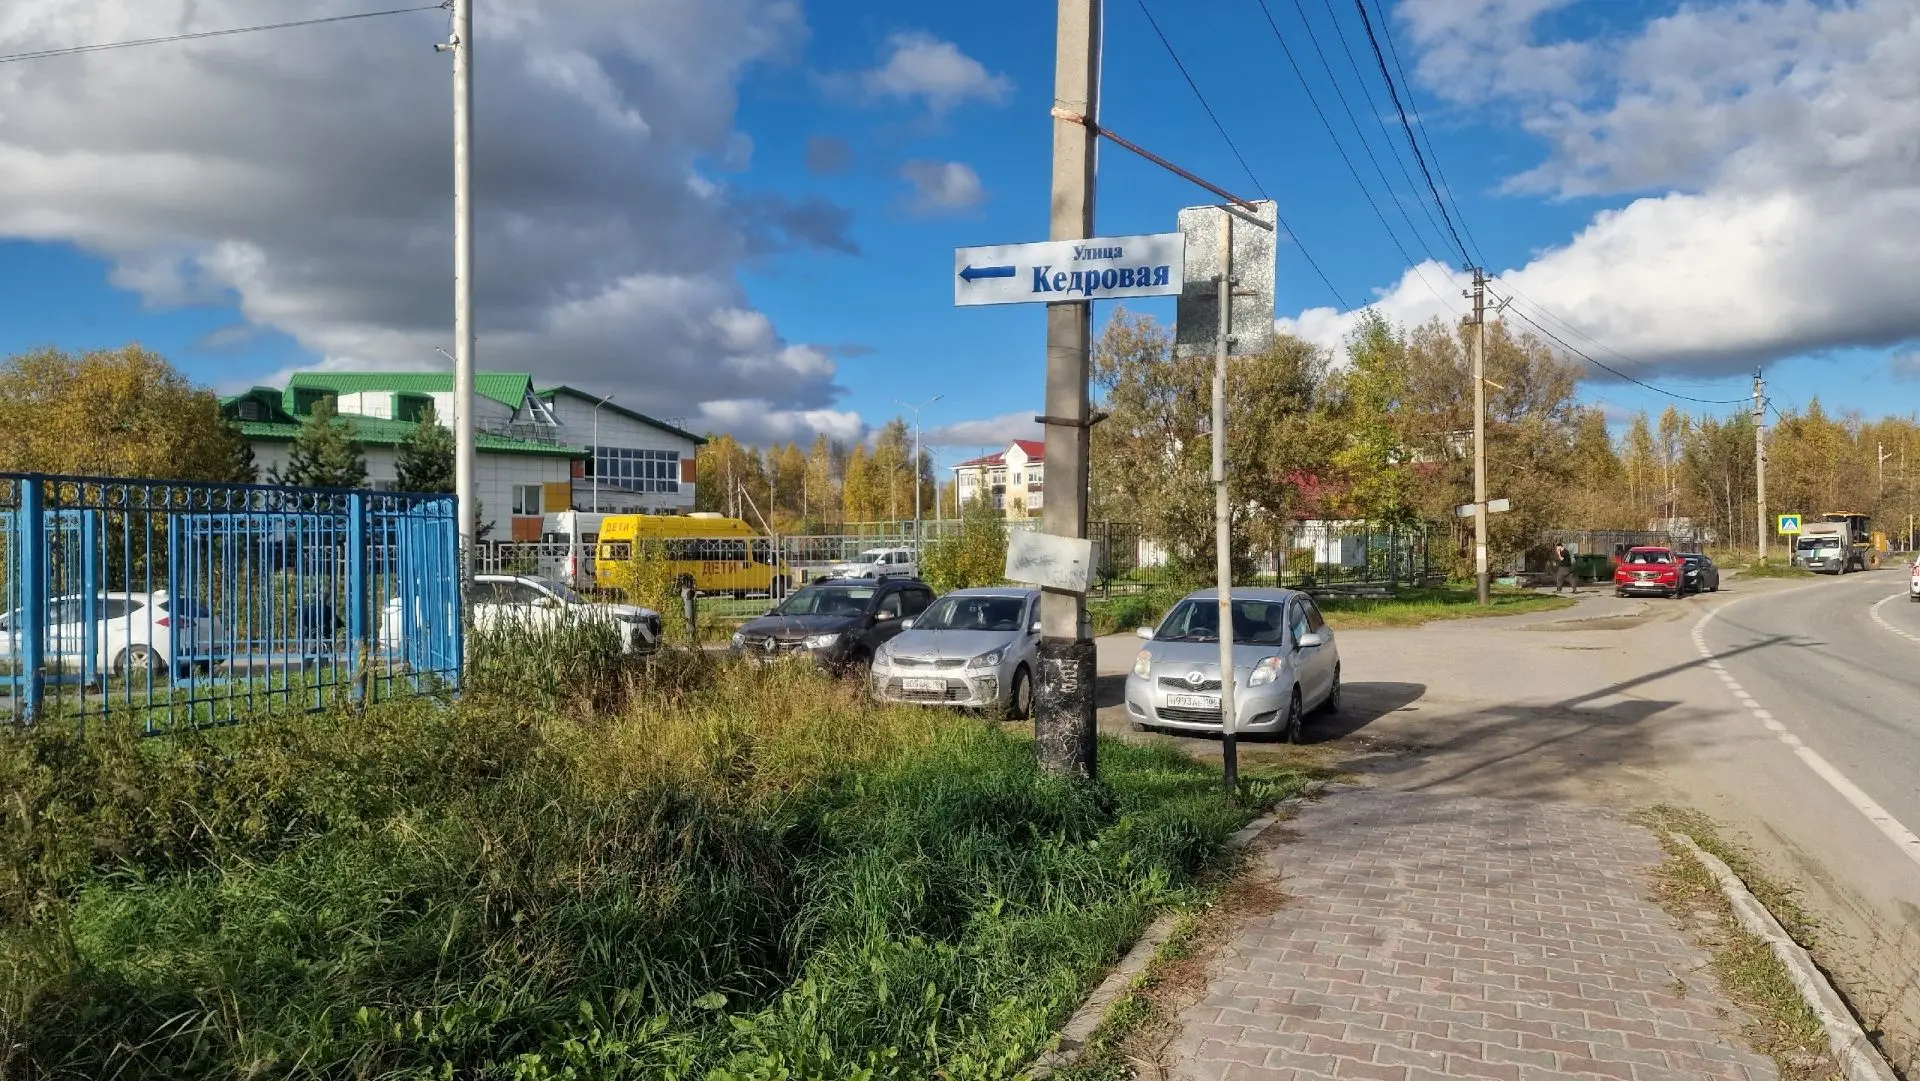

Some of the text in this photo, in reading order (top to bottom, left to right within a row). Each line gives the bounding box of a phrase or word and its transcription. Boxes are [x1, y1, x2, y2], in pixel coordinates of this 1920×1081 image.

[1072, 245, 1123, 260] Улица
[1032, 264, 1170, 296] Кедровая
[605, 522, 629, 532] ДЕТИ
[702, 562, 737, 576] ДЕТИ
